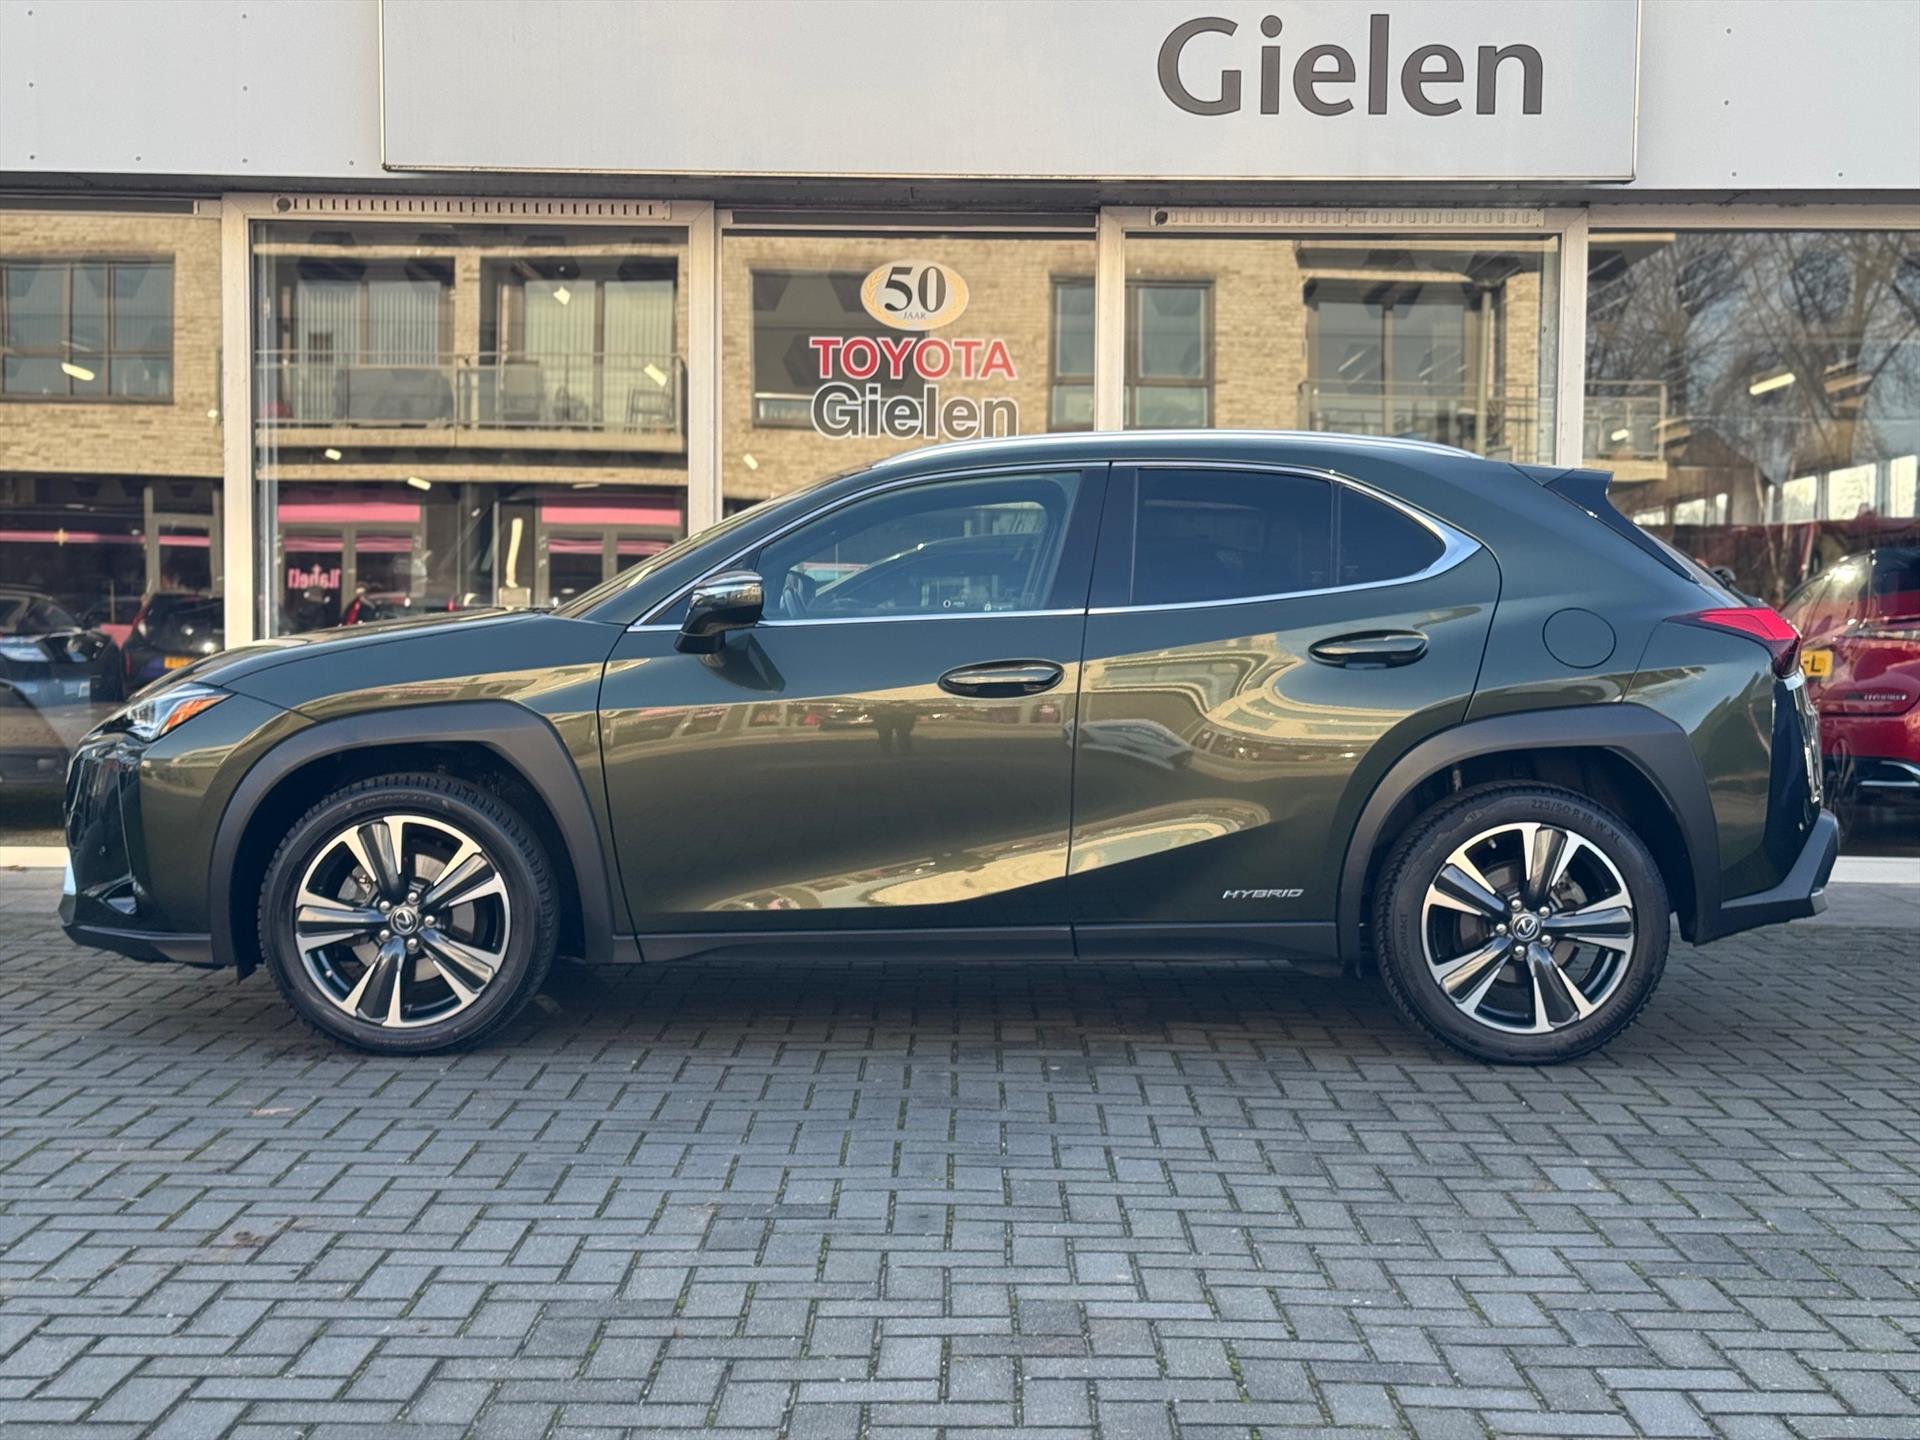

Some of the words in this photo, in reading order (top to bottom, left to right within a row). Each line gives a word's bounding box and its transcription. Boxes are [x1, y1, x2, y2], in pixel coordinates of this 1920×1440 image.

[1157, 13, 1543, 116] Gielen
[884, 266, 946, 313] 50
[903, 311, 927, 321] JAAR
[809, 336, 1018, 380] TOYOTA
[811, 382, 1019, 440] Gielen
[1222, 888, 1304, 899] HYBRID
